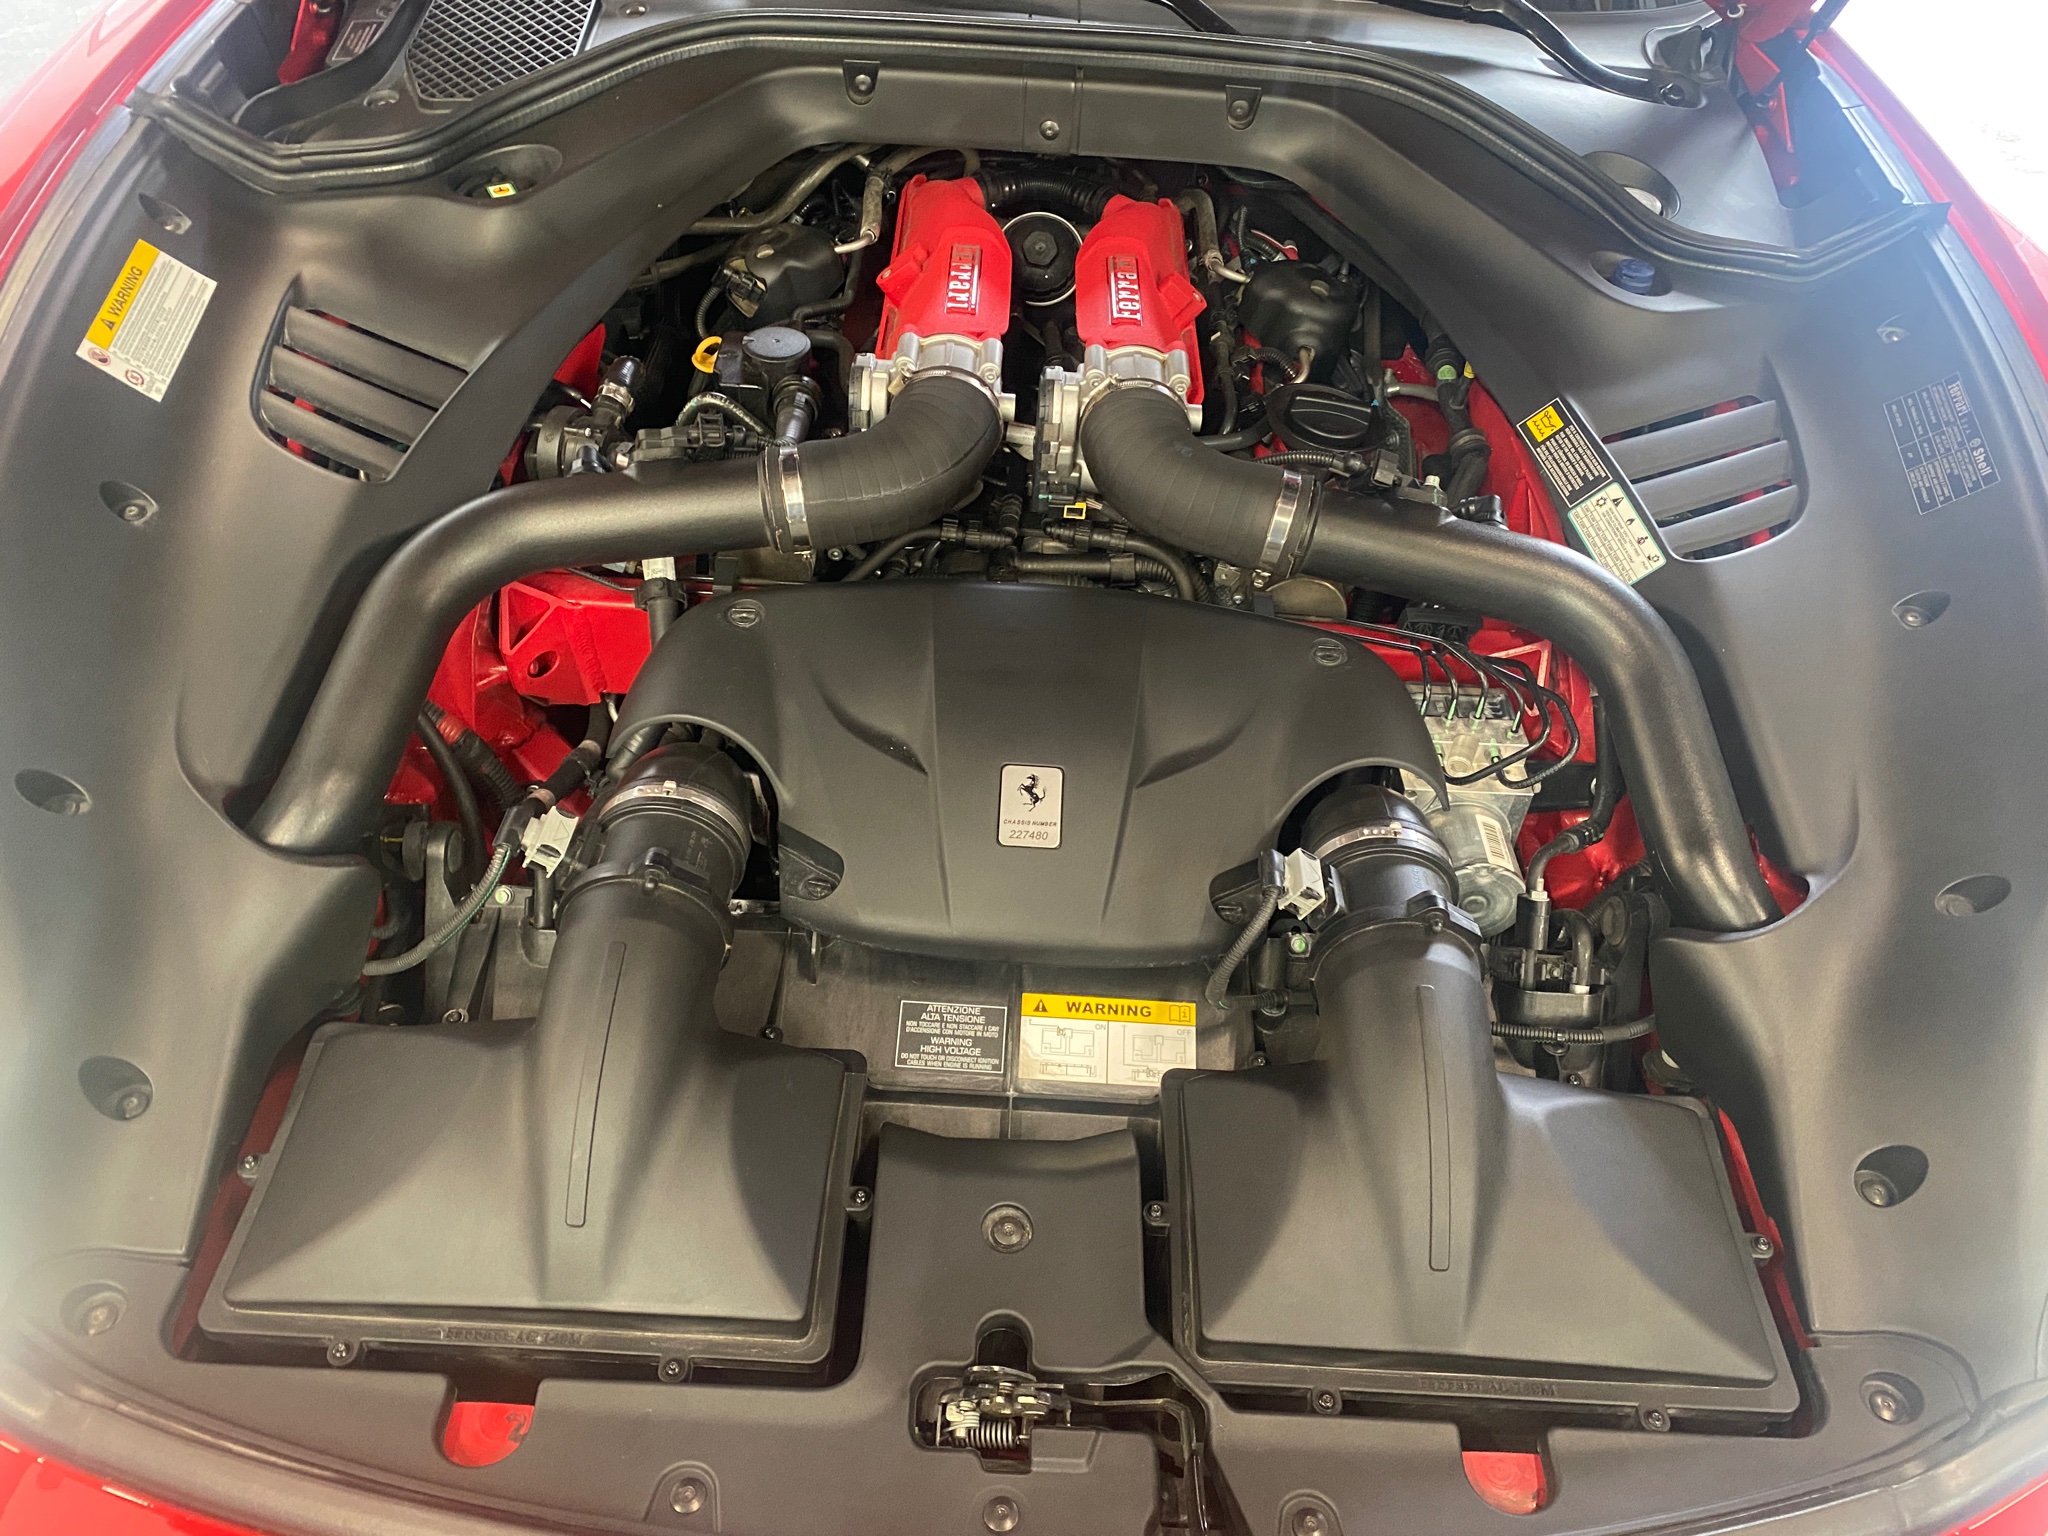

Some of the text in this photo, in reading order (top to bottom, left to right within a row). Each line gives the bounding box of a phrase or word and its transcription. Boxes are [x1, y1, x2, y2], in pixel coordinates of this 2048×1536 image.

[947, 244, 981, 310] Ferrari
[108, 266, 143, 317] WARNING
[1947, 380, 1970, 416] Ferrari
[1972, 446, 1992, 476] Shell
[1003, 818, 1057, 828] CHASSIS NUMBER
[1009, 829, 1049, 841] 227480
[926, 1004, 980, 1014] ATTENZIONE
[1066, 1001, 1151, 1017] WARNING
[920, 1012, 985, 1023] ALTA TENSIONE
[930, 1036, 972, 1046] WARNING
[919, 1044, 981, 1055] HIGH VOLTAGE
[945, 1055, 976, 1063] DISCONNECT
